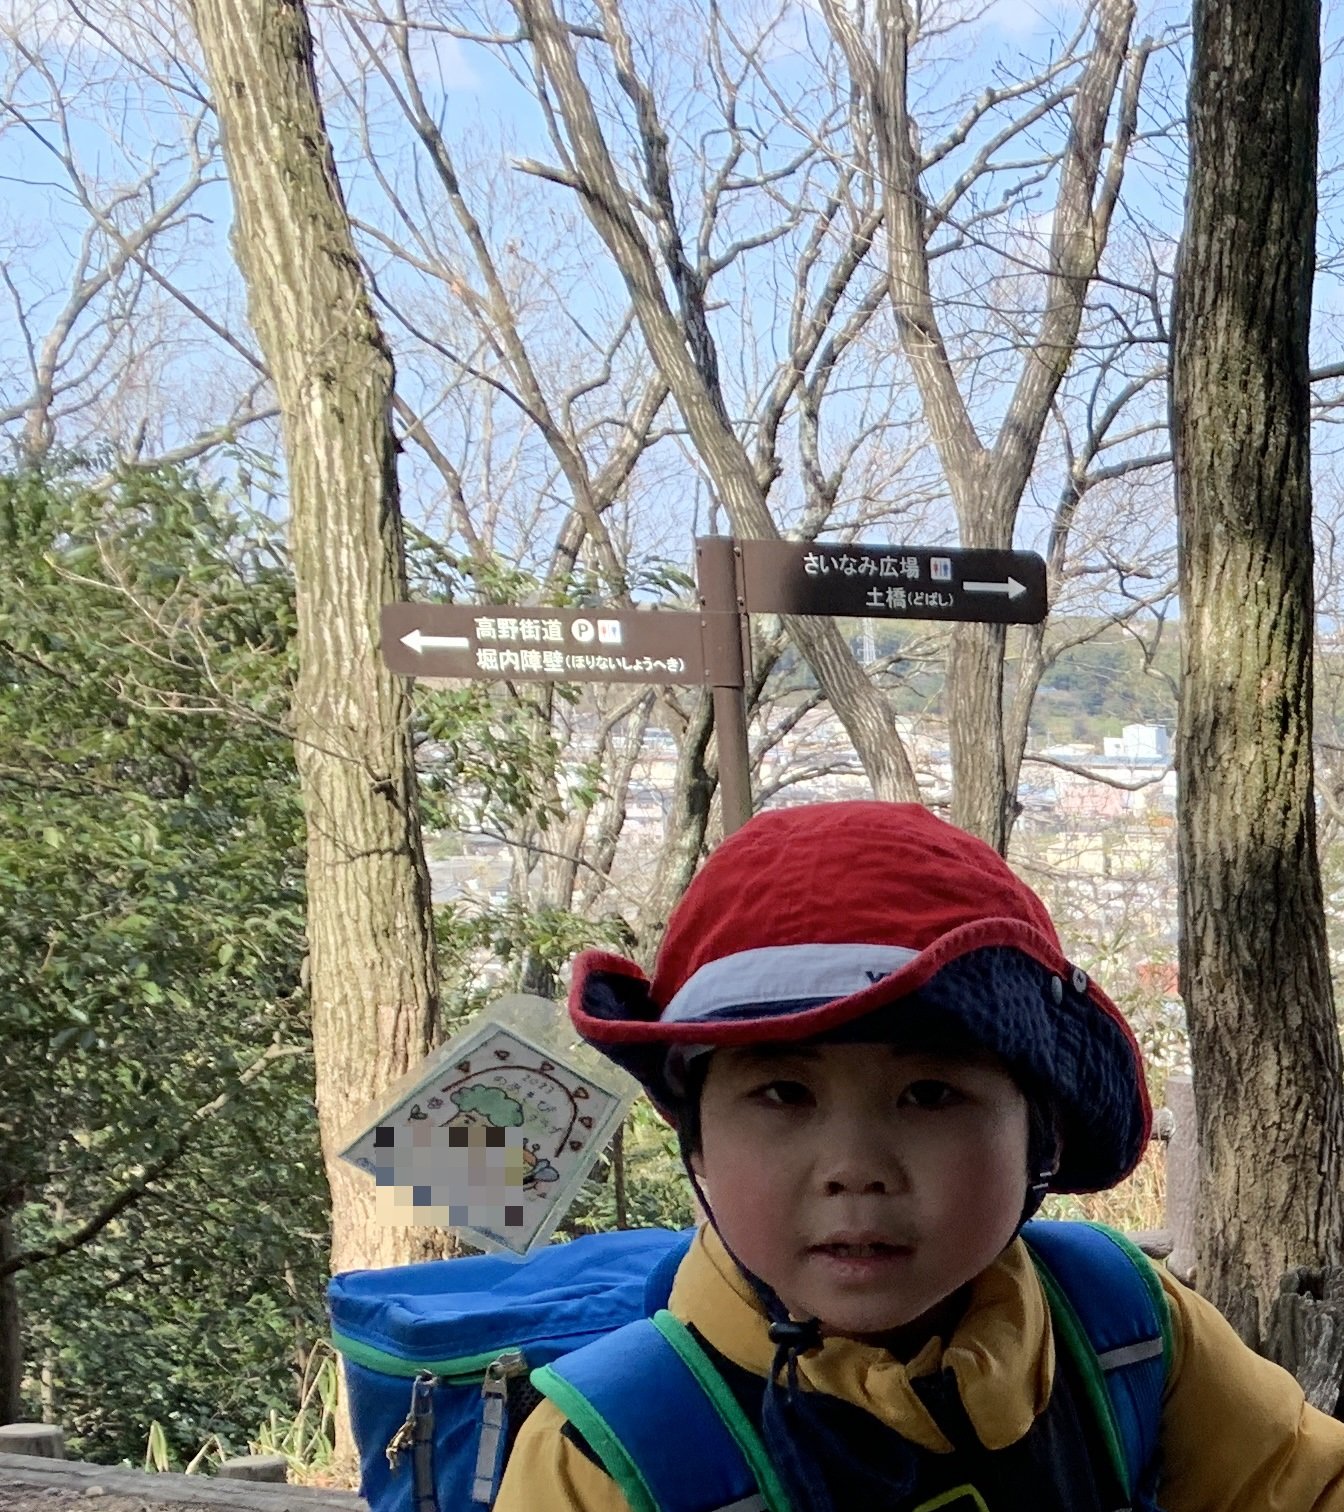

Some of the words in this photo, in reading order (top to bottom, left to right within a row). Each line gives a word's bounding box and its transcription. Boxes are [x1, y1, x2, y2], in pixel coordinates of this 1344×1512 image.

[803, 552, 919, 579] さいなみ広場
[474, 616, 564, 641] 高野街道
